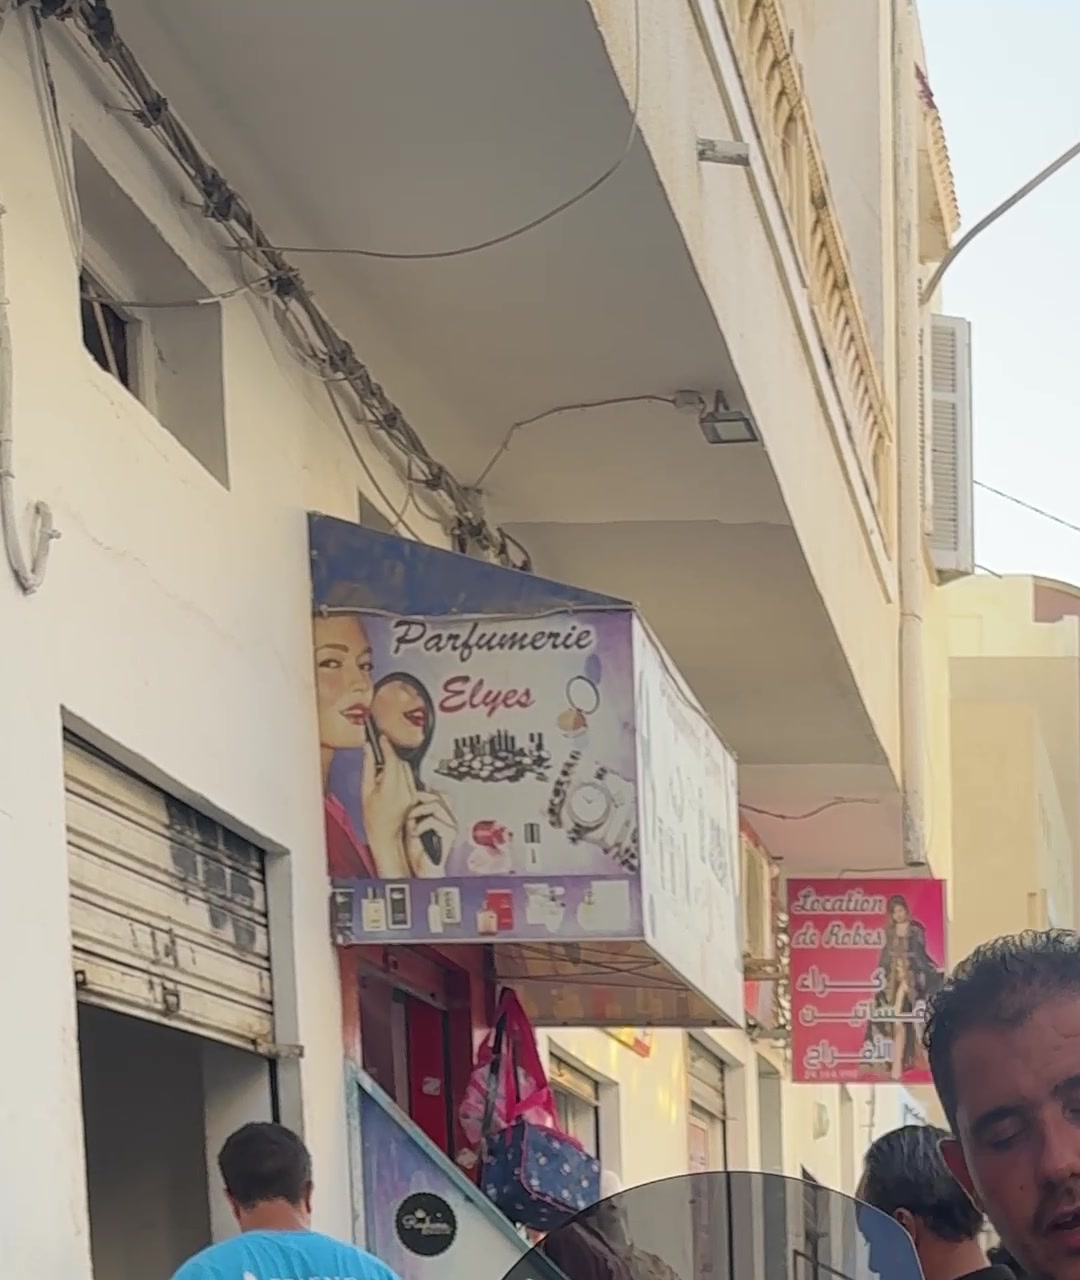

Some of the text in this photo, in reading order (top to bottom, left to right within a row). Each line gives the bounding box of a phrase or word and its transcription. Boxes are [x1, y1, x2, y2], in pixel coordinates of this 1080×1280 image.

[393, 620, 592, 663] Parfumerie
[439, 675, 535, 718] Elyes
[793, 887, 885, 913] Location
[793, 922, 885, 948] de Robes
